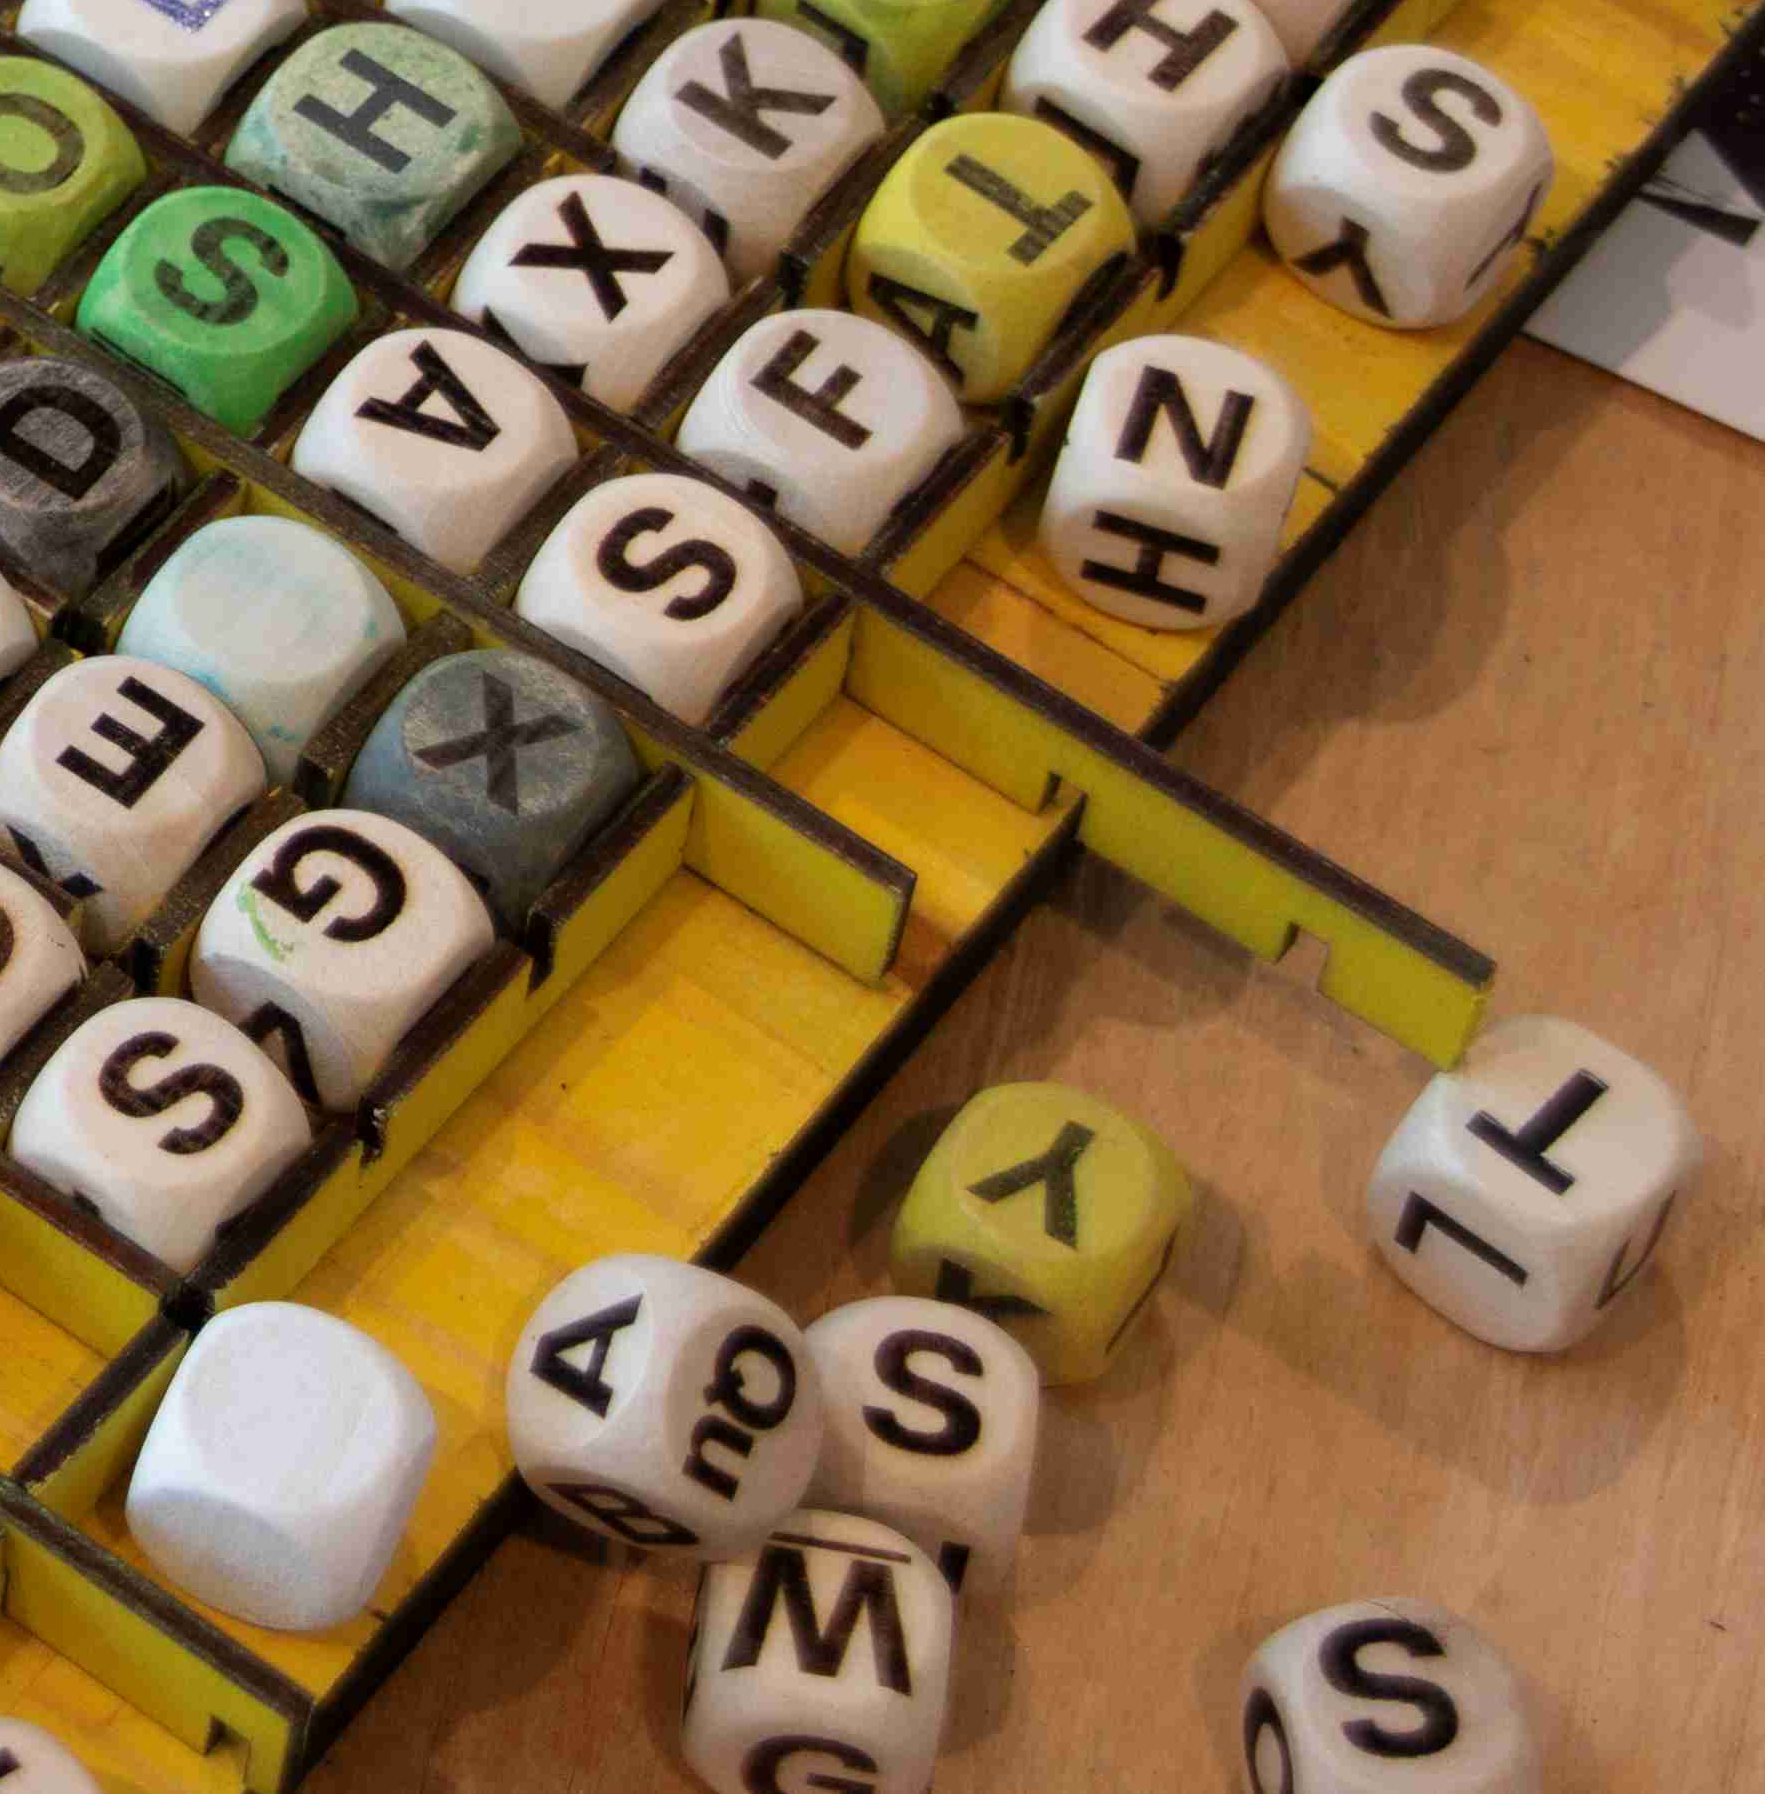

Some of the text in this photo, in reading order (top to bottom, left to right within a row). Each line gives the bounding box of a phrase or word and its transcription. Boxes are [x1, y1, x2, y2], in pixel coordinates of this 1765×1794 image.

[677, 35, 836, 159] K
[1372, 69, 1502, 172] S
[512, 193, 672, 320] X
[357, 342, 500, 451] A
[752, 330, 871, 449] F
[597, 508, 736, 620] S
[58, 677, 204, 808] E
[253, 827, 406, 942] G
[100, 1033, 243, 1155] S
[1469, 1072, 1608, 1194] T
[1395, 1193, 1528, 1285] L
[531, 1300, 639, 1417] A
[864, 1331, 983, 1457] S
